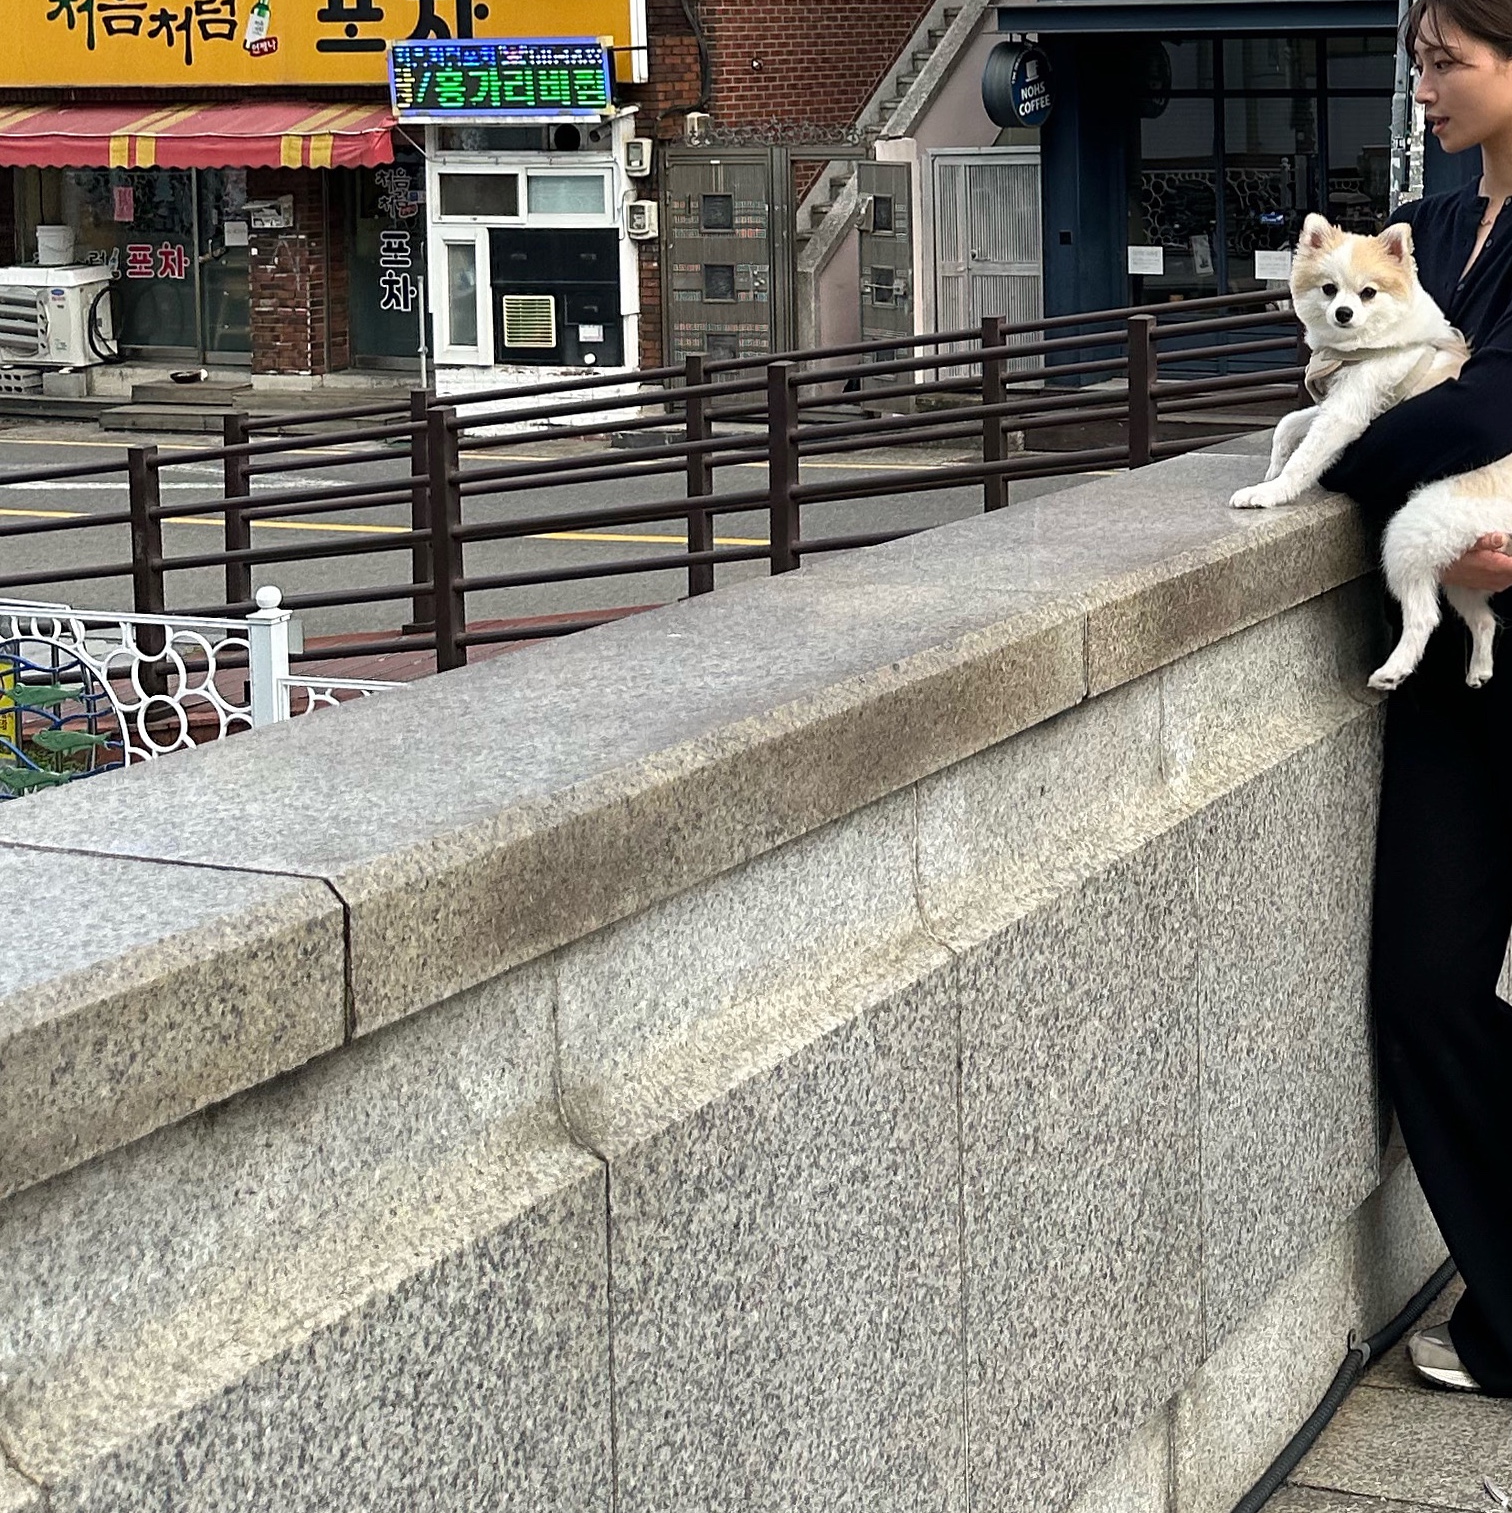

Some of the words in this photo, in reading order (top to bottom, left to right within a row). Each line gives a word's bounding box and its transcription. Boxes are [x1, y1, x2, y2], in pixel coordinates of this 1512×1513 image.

[1018, 94, 1052, 117] COFFEE
[1020, 81, 1046, 101] NOHS
[127, 241, 191, 279] 포차
[380, 230, 418, 313] 포차
